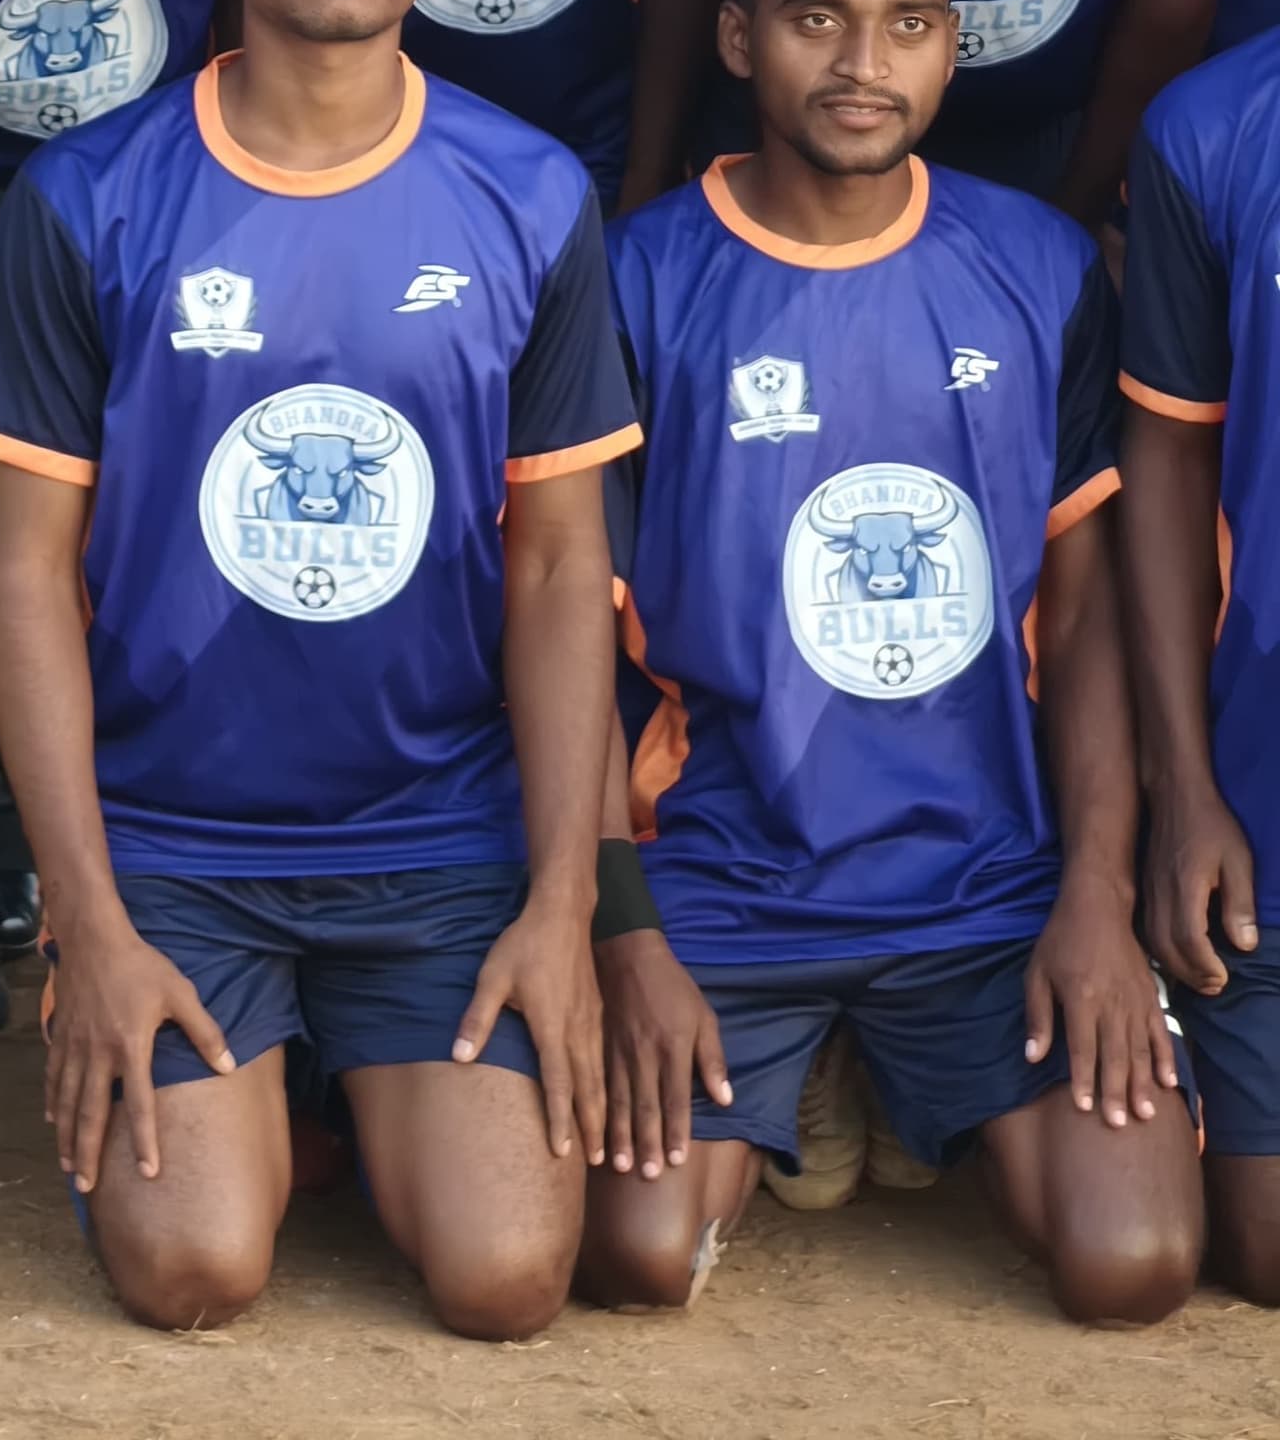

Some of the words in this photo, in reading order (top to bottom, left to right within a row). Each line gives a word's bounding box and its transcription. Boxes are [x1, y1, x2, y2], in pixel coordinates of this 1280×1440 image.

[268, 405, 382, 442] BHANDRA
[828, 482, 938, 518] BHANDRA
[236, 522, 400, 569] BULLS
[815, 600, 970, 647] BULLS
